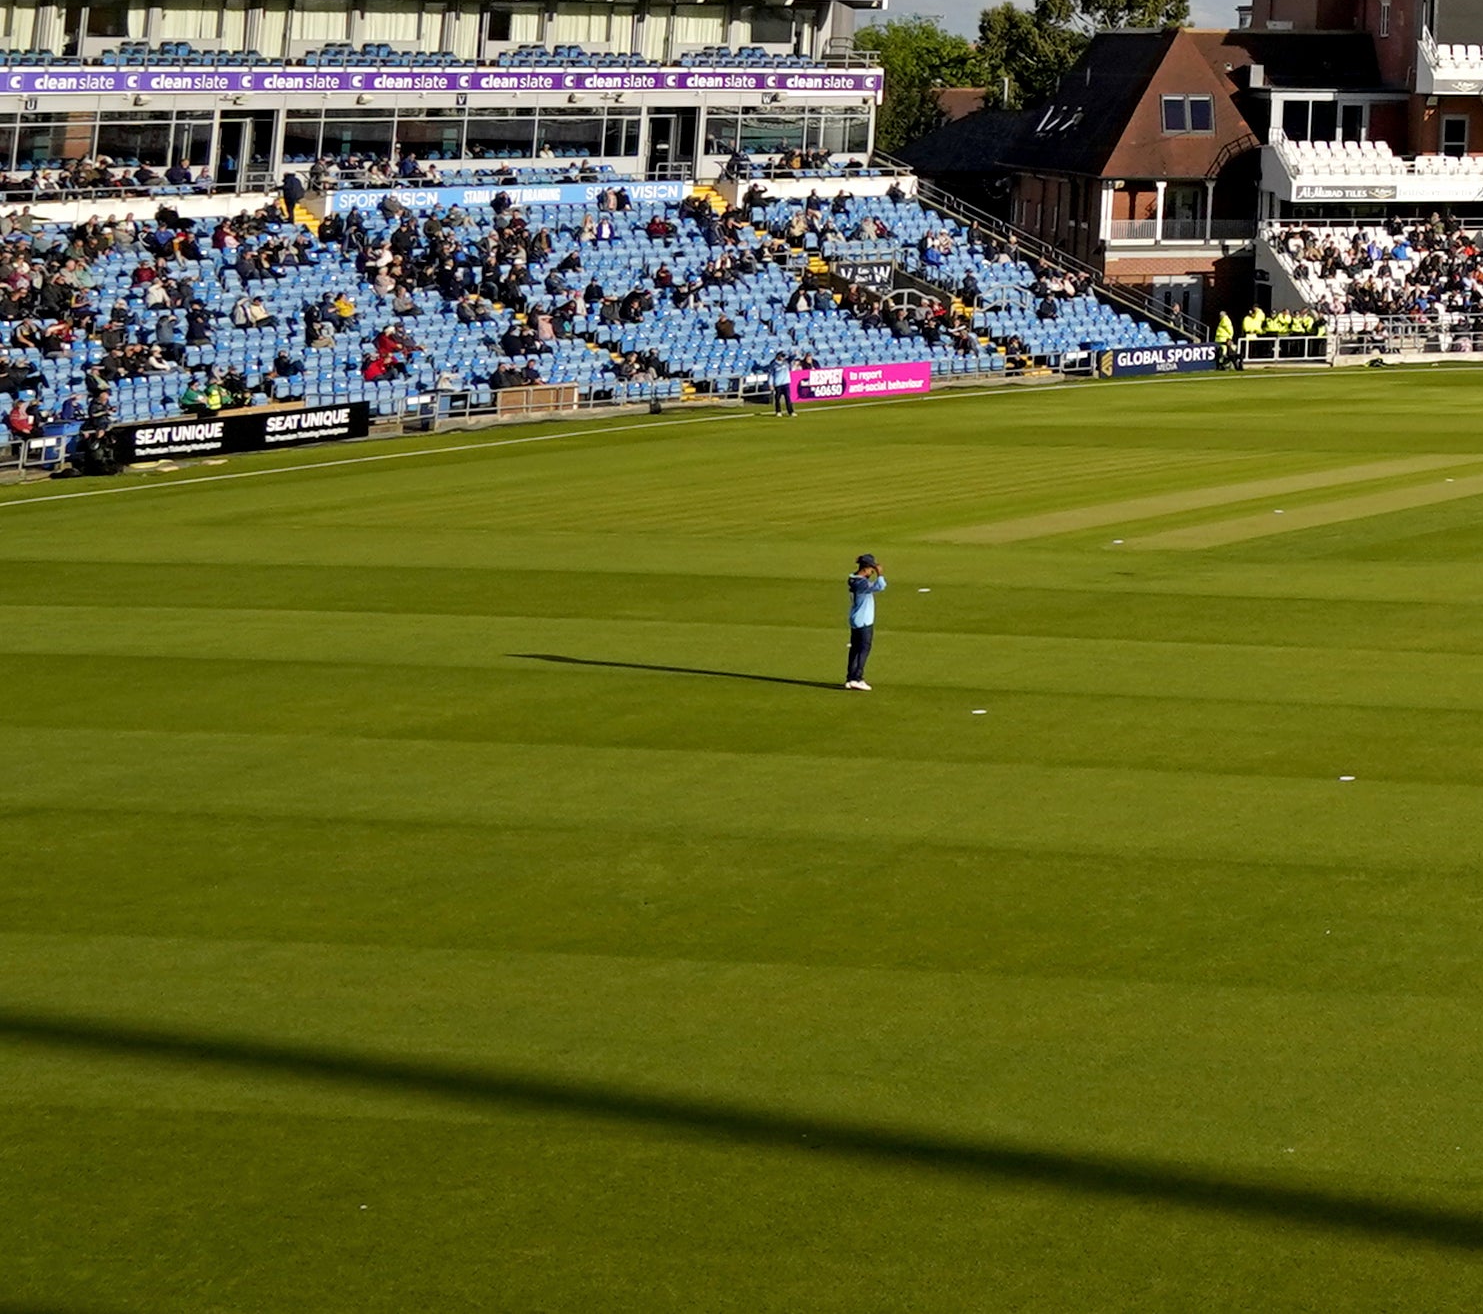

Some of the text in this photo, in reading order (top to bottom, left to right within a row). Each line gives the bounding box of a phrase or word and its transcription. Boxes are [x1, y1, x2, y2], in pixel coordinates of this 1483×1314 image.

[631, 184, 678, 199] VISION
[1117, 346, 1215, 366] GLOBAL SPORTS
[1156, 363, 1177, 371] MEDIA
[849, 370, 882, 381] to report
[849, 379, 924, 393] anti-social behaviour
[266, 408, 350, 432] SEAT UNIQUE
[135, 422, 224, 445] SEAT UNIQUE
